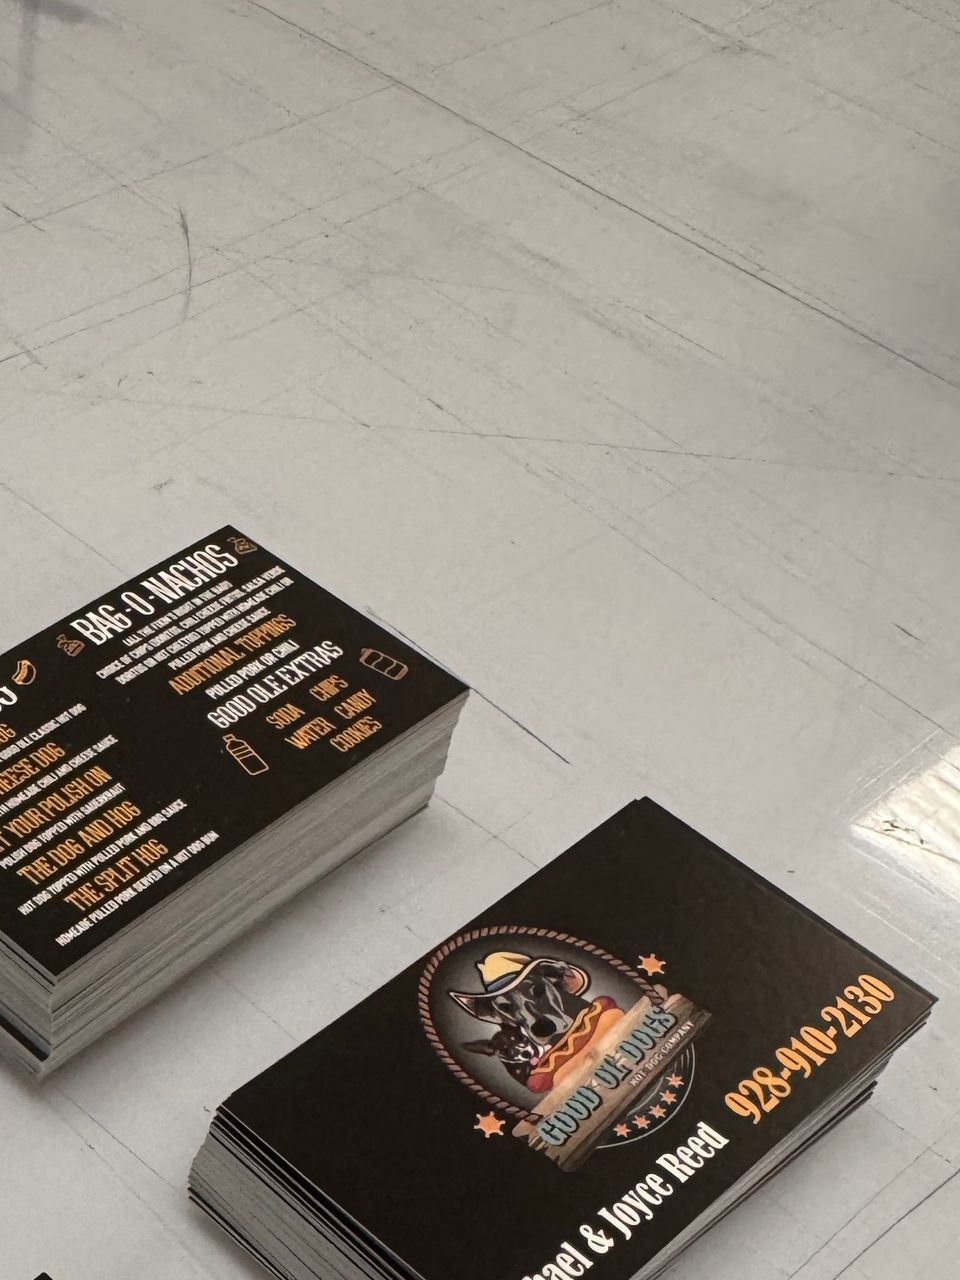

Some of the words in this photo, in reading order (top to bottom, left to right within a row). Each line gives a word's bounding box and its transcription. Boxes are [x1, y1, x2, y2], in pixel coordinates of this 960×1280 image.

[168, 646, 247, 696] ADDITIONAL
[233, 613, 297, 652] TOPPINGS
[206, 694, 257, 729] GOOD
[246, 674, 289, 704] OLE
[274, 640, 344, 686] EXTRAS
[28, 742, 66, 768] DOG
[265, 703, 306, 730] SODA
[283, 716, 337, 750] WATER
[329, 715, 383, 753] COOKIES
[2, 807, 52, 839] YOUR
[37, 777, 95, 817] POLISH
[83, 765, 113, 787] ON
[15, 855, 59, 886] THE
[46, 838, 86, 867] DOG
[77, 819, 114, 848] AND
[102, 800, 142, 829] HOG
[63, 881, 105, 912] THE
[93, 855, 141, 892] SPLIT
[130, 838, 169, 867] HOG
[537, 1085, 603, 1146] GOOD
[618, 1005, 678, 1065] DOGS
[725, 975, 894, 1124] 928-910-2130
[580, 1225, 614, 1253] &
[598, 1174, 673, 1240] Joyce
[656, 1122, 729, 1183] Reed
